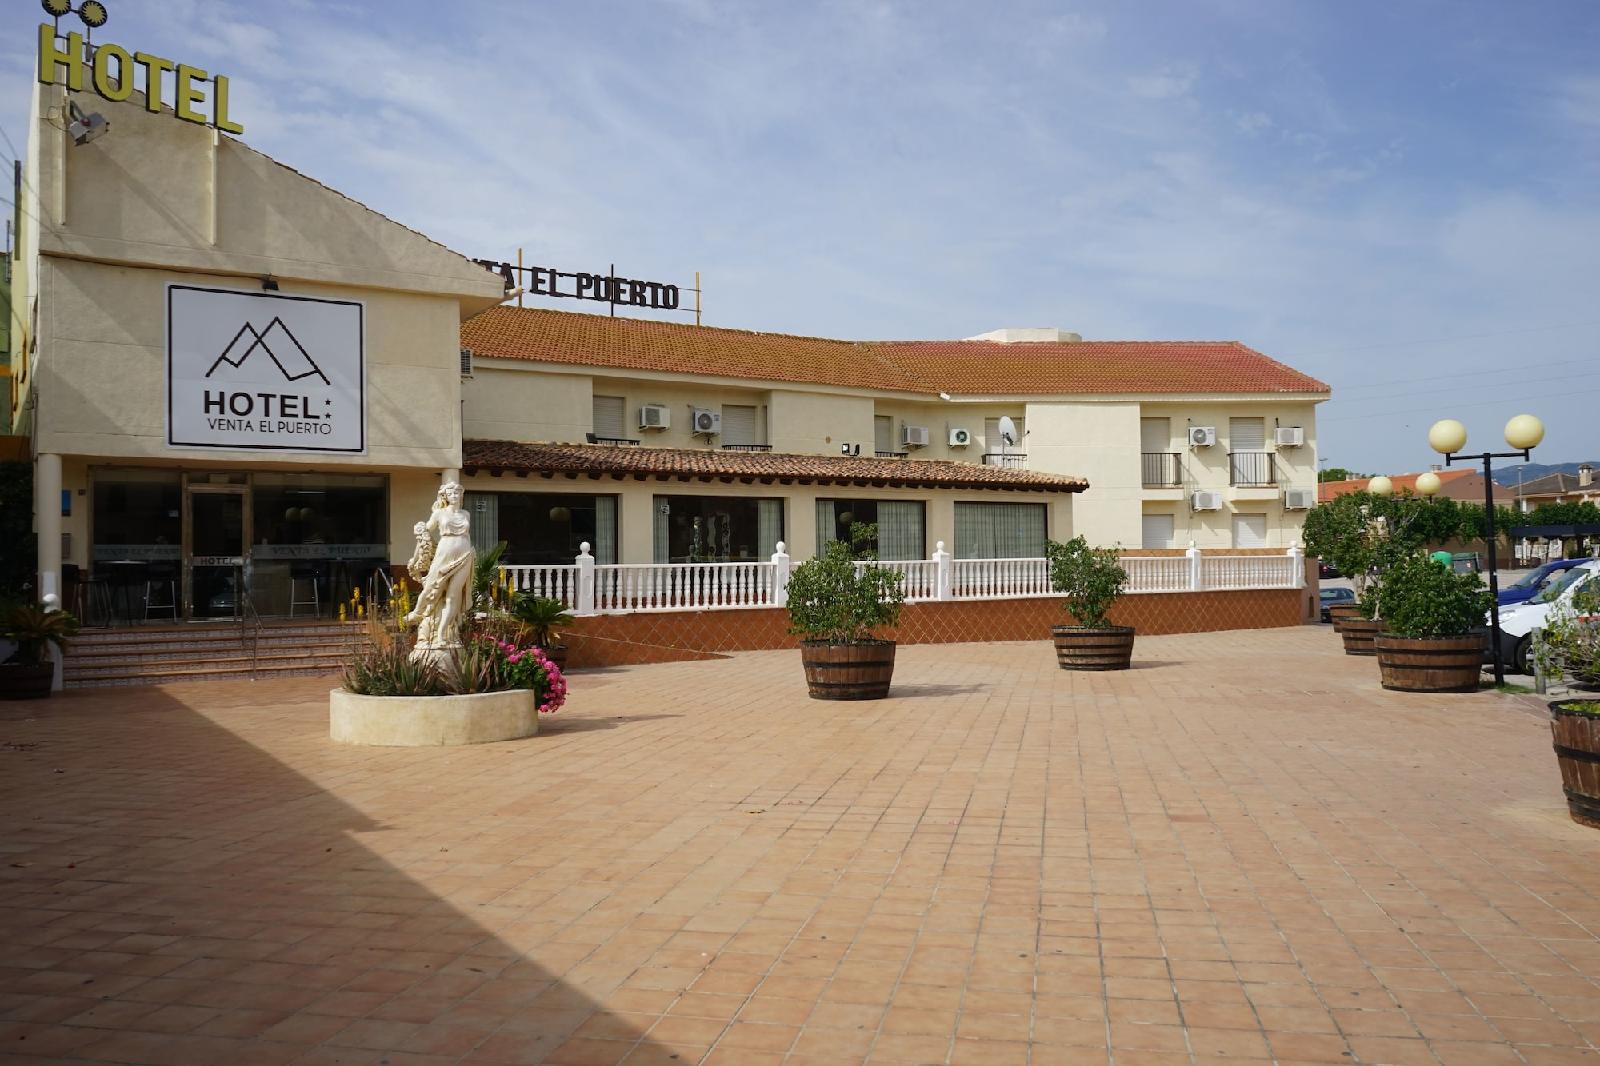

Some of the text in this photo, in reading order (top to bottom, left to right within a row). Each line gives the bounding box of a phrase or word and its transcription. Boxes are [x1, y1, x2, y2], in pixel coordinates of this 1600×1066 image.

[38, 23, 243, 135] HOTEL
[529, 266, 564, 298] EL
[576, 272, 679, 310] PUERTO
[204, 390, 320, 420] HOTEL
[207, 418, 332, 435] VENTA EL PUERTO
